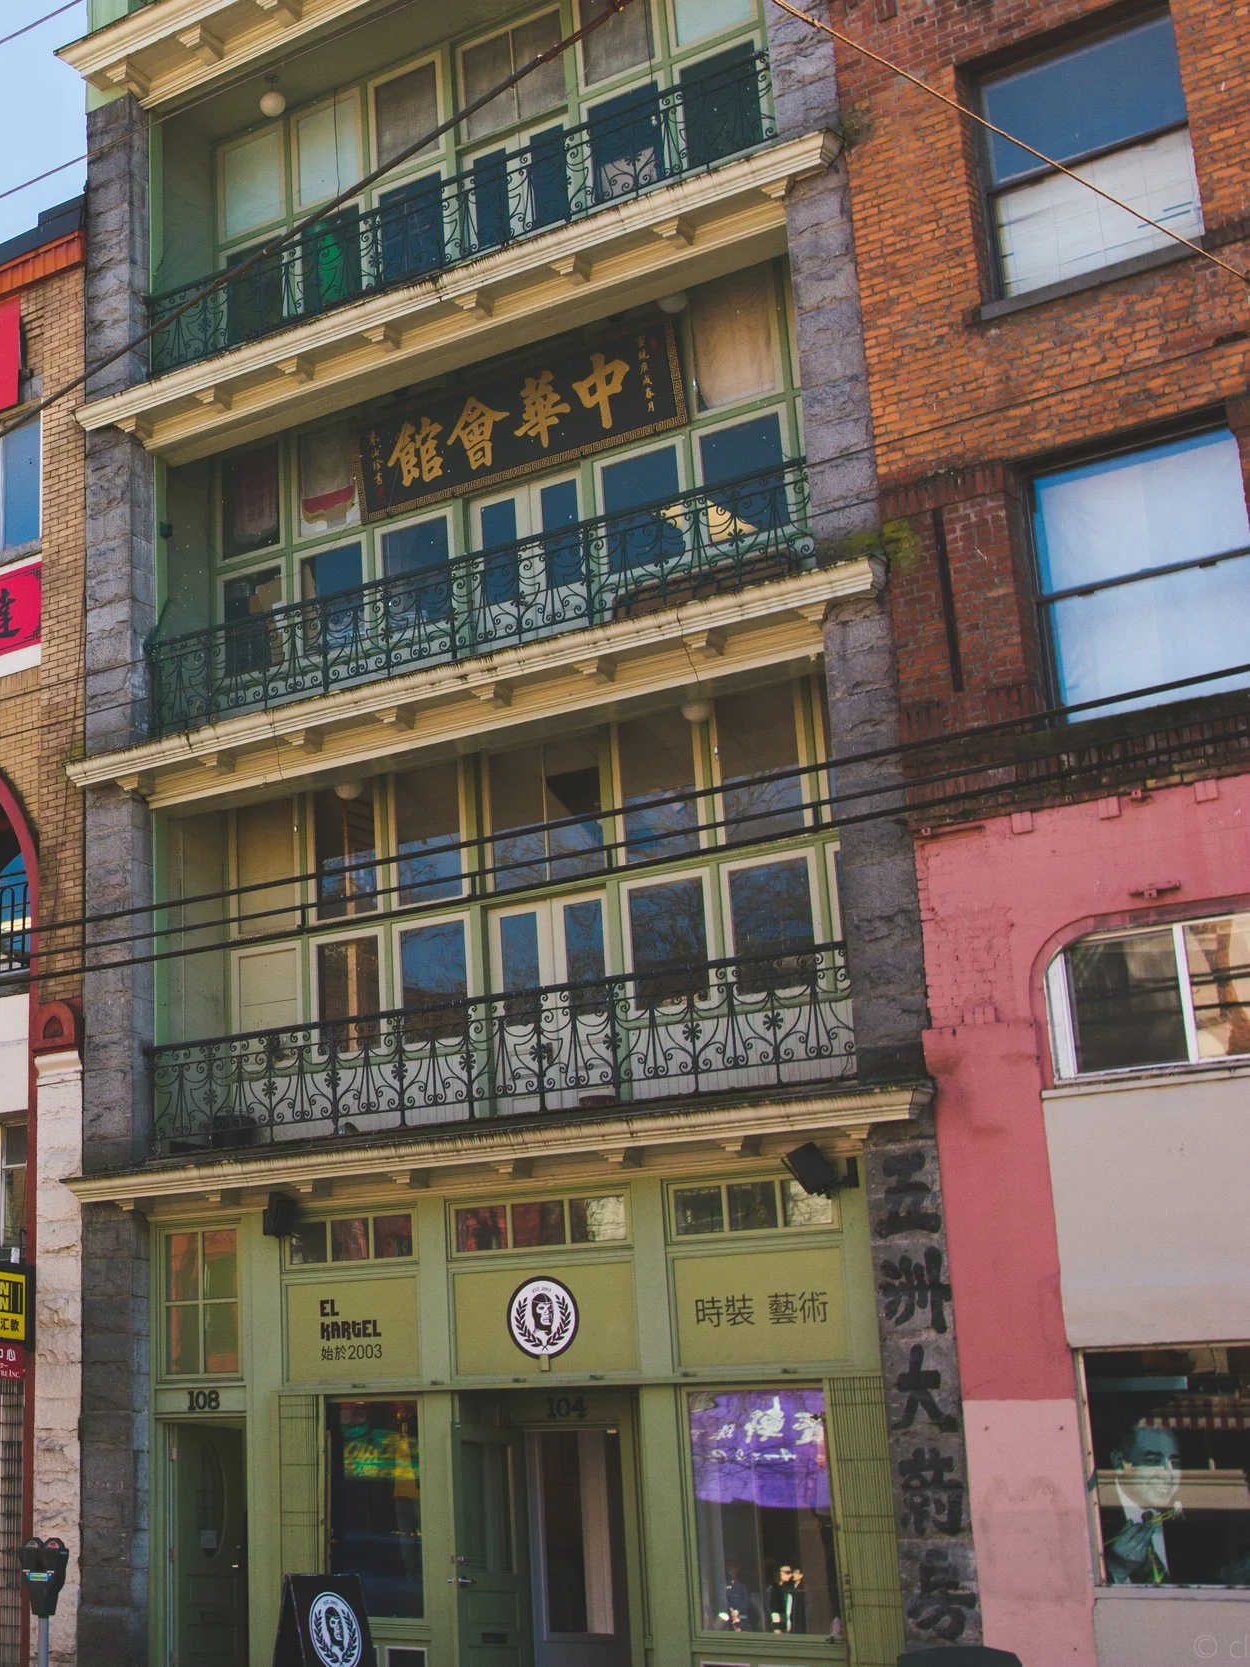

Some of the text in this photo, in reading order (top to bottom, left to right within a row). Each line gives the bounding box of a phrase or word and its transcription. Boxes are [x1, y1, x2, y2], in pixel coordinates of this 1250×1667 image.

[387, 353, 631, 487] 中華會館
[320, 1299, 339, 1317] EL
[695, 1290, 829, 1328] 時裝 藝術
[187, 1391, 220, 1412] 108
[546, 1395, 587, 1419] 104
